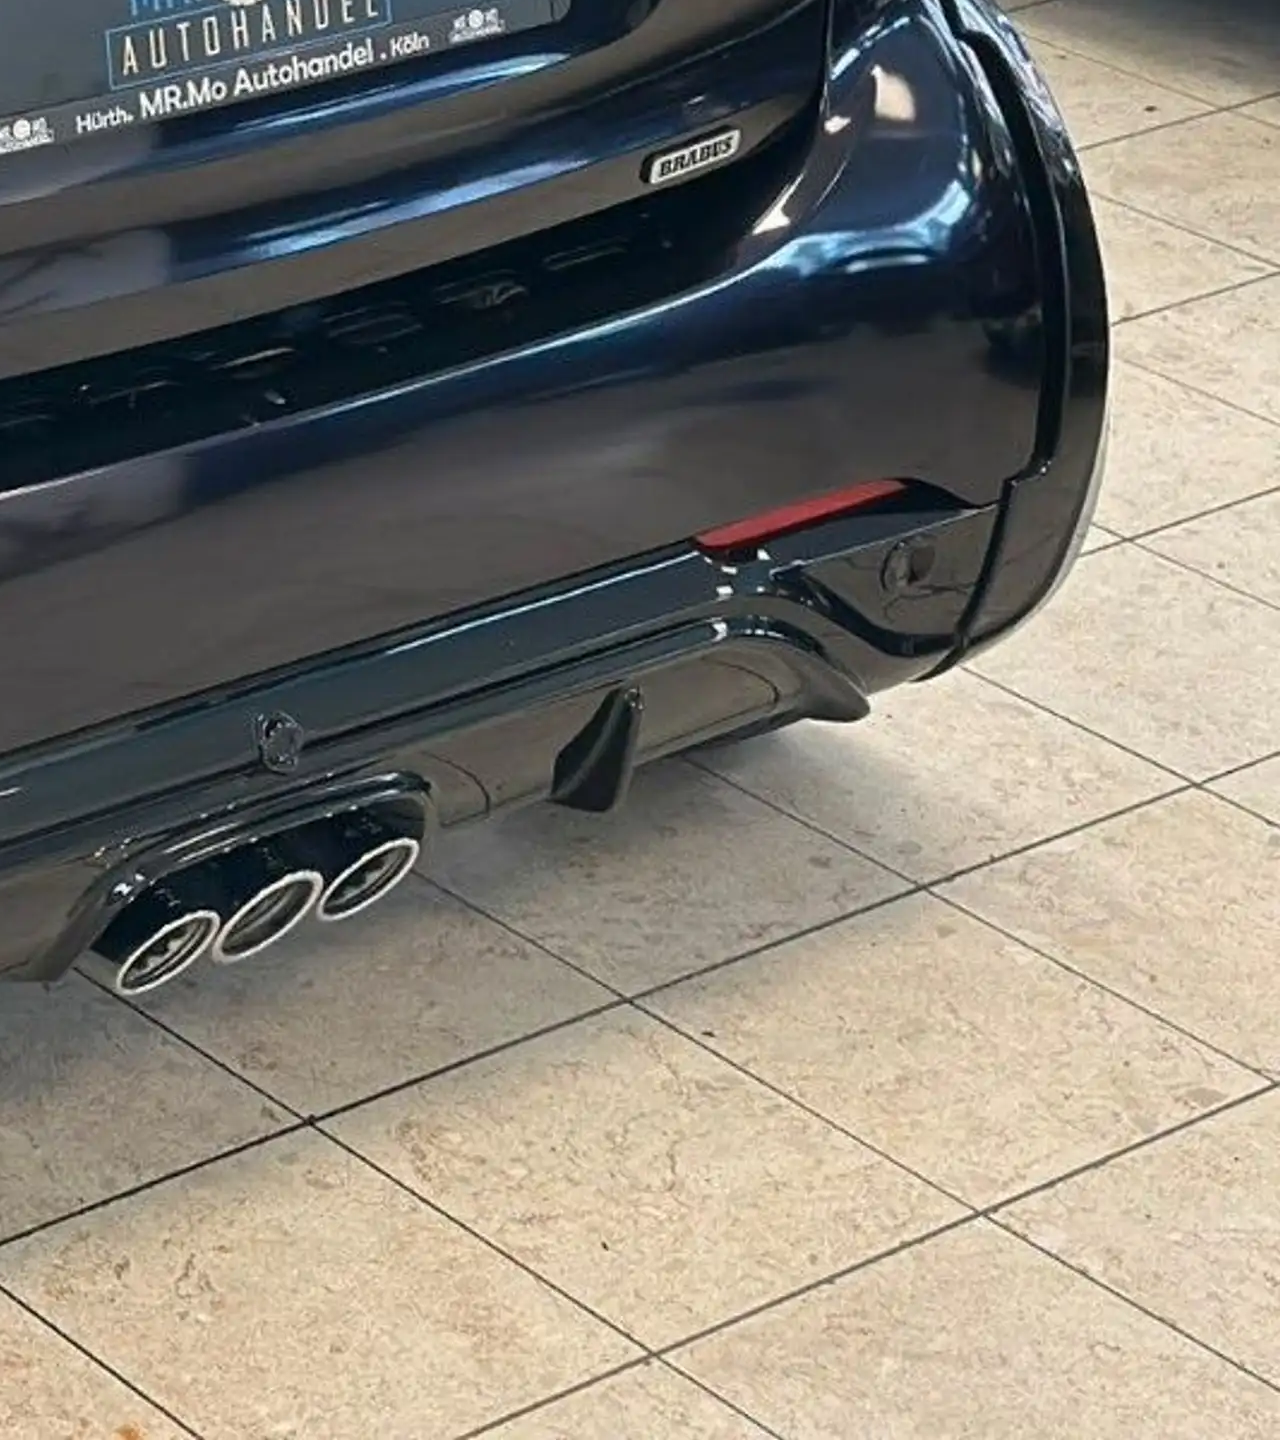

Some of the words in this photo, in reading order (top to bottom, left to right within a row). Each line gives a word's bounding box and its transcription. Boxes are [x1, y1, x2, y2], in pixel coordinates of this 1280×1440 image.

[140, 75, 228, 119] MR.Mo
[233, 37, 374, 97] Autohandel
[390, 31, 430, 58] Köln
[659, 135, 734, 176] BRABUS
